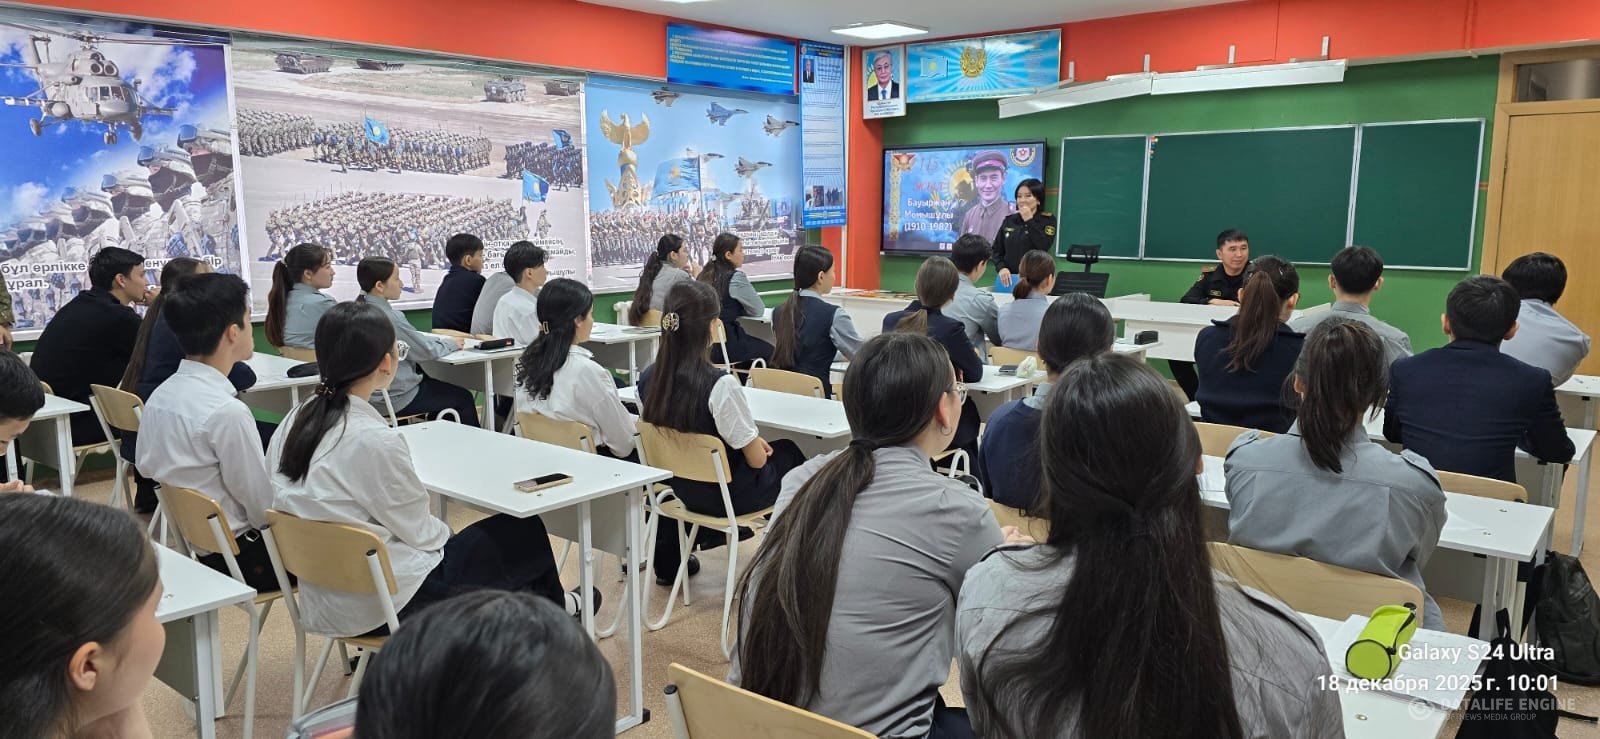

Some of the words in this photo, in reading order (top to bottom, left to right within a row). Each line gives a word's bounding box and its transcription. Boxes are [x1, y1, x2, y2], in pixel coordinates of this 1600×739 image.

[550, 248, 576, 256] майды,
[1, 262, 29, 275] бұл
[33, 261, 86, 275] ерлікке
